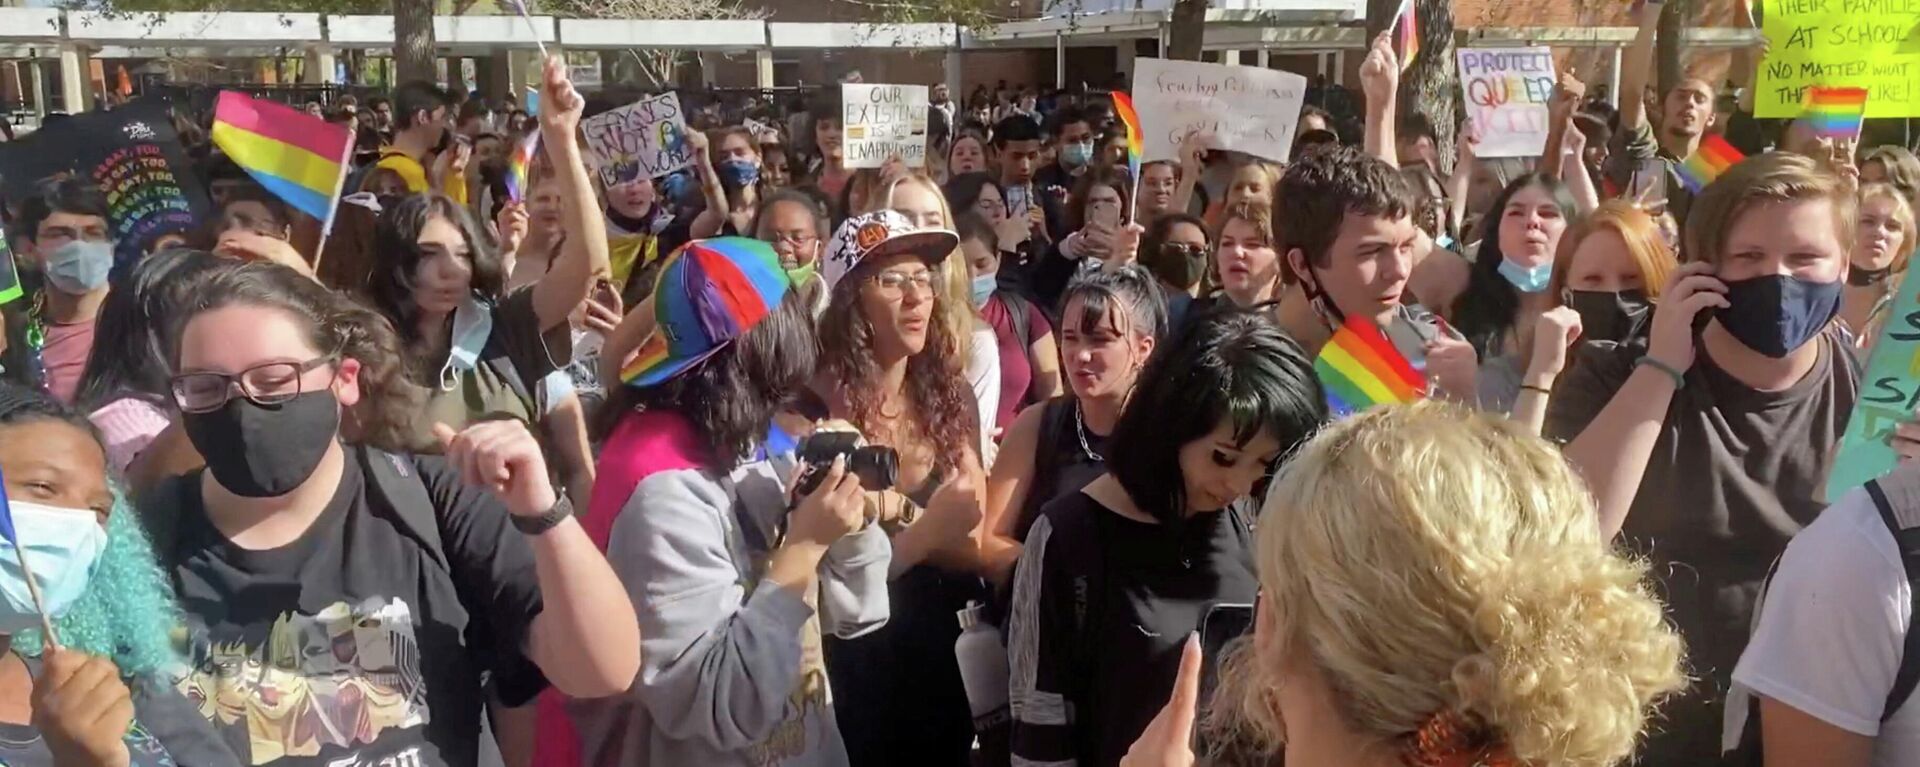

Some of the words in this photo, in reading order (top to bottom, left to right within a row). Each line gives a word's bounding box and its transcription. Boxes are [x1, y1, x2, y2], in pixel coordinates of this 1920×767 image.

[1785, 26, 1819, 49] AT
[1829, 22, 1909, 46] SCHOOL
[1462, 52, 1550, 75] PROTECT
[1768, 60, 1792, 81] NO
[1801, 61, 1868, 79] MATTER
[870, 86, 902, 104] OUR
[871, 125, 885, 137] IS
